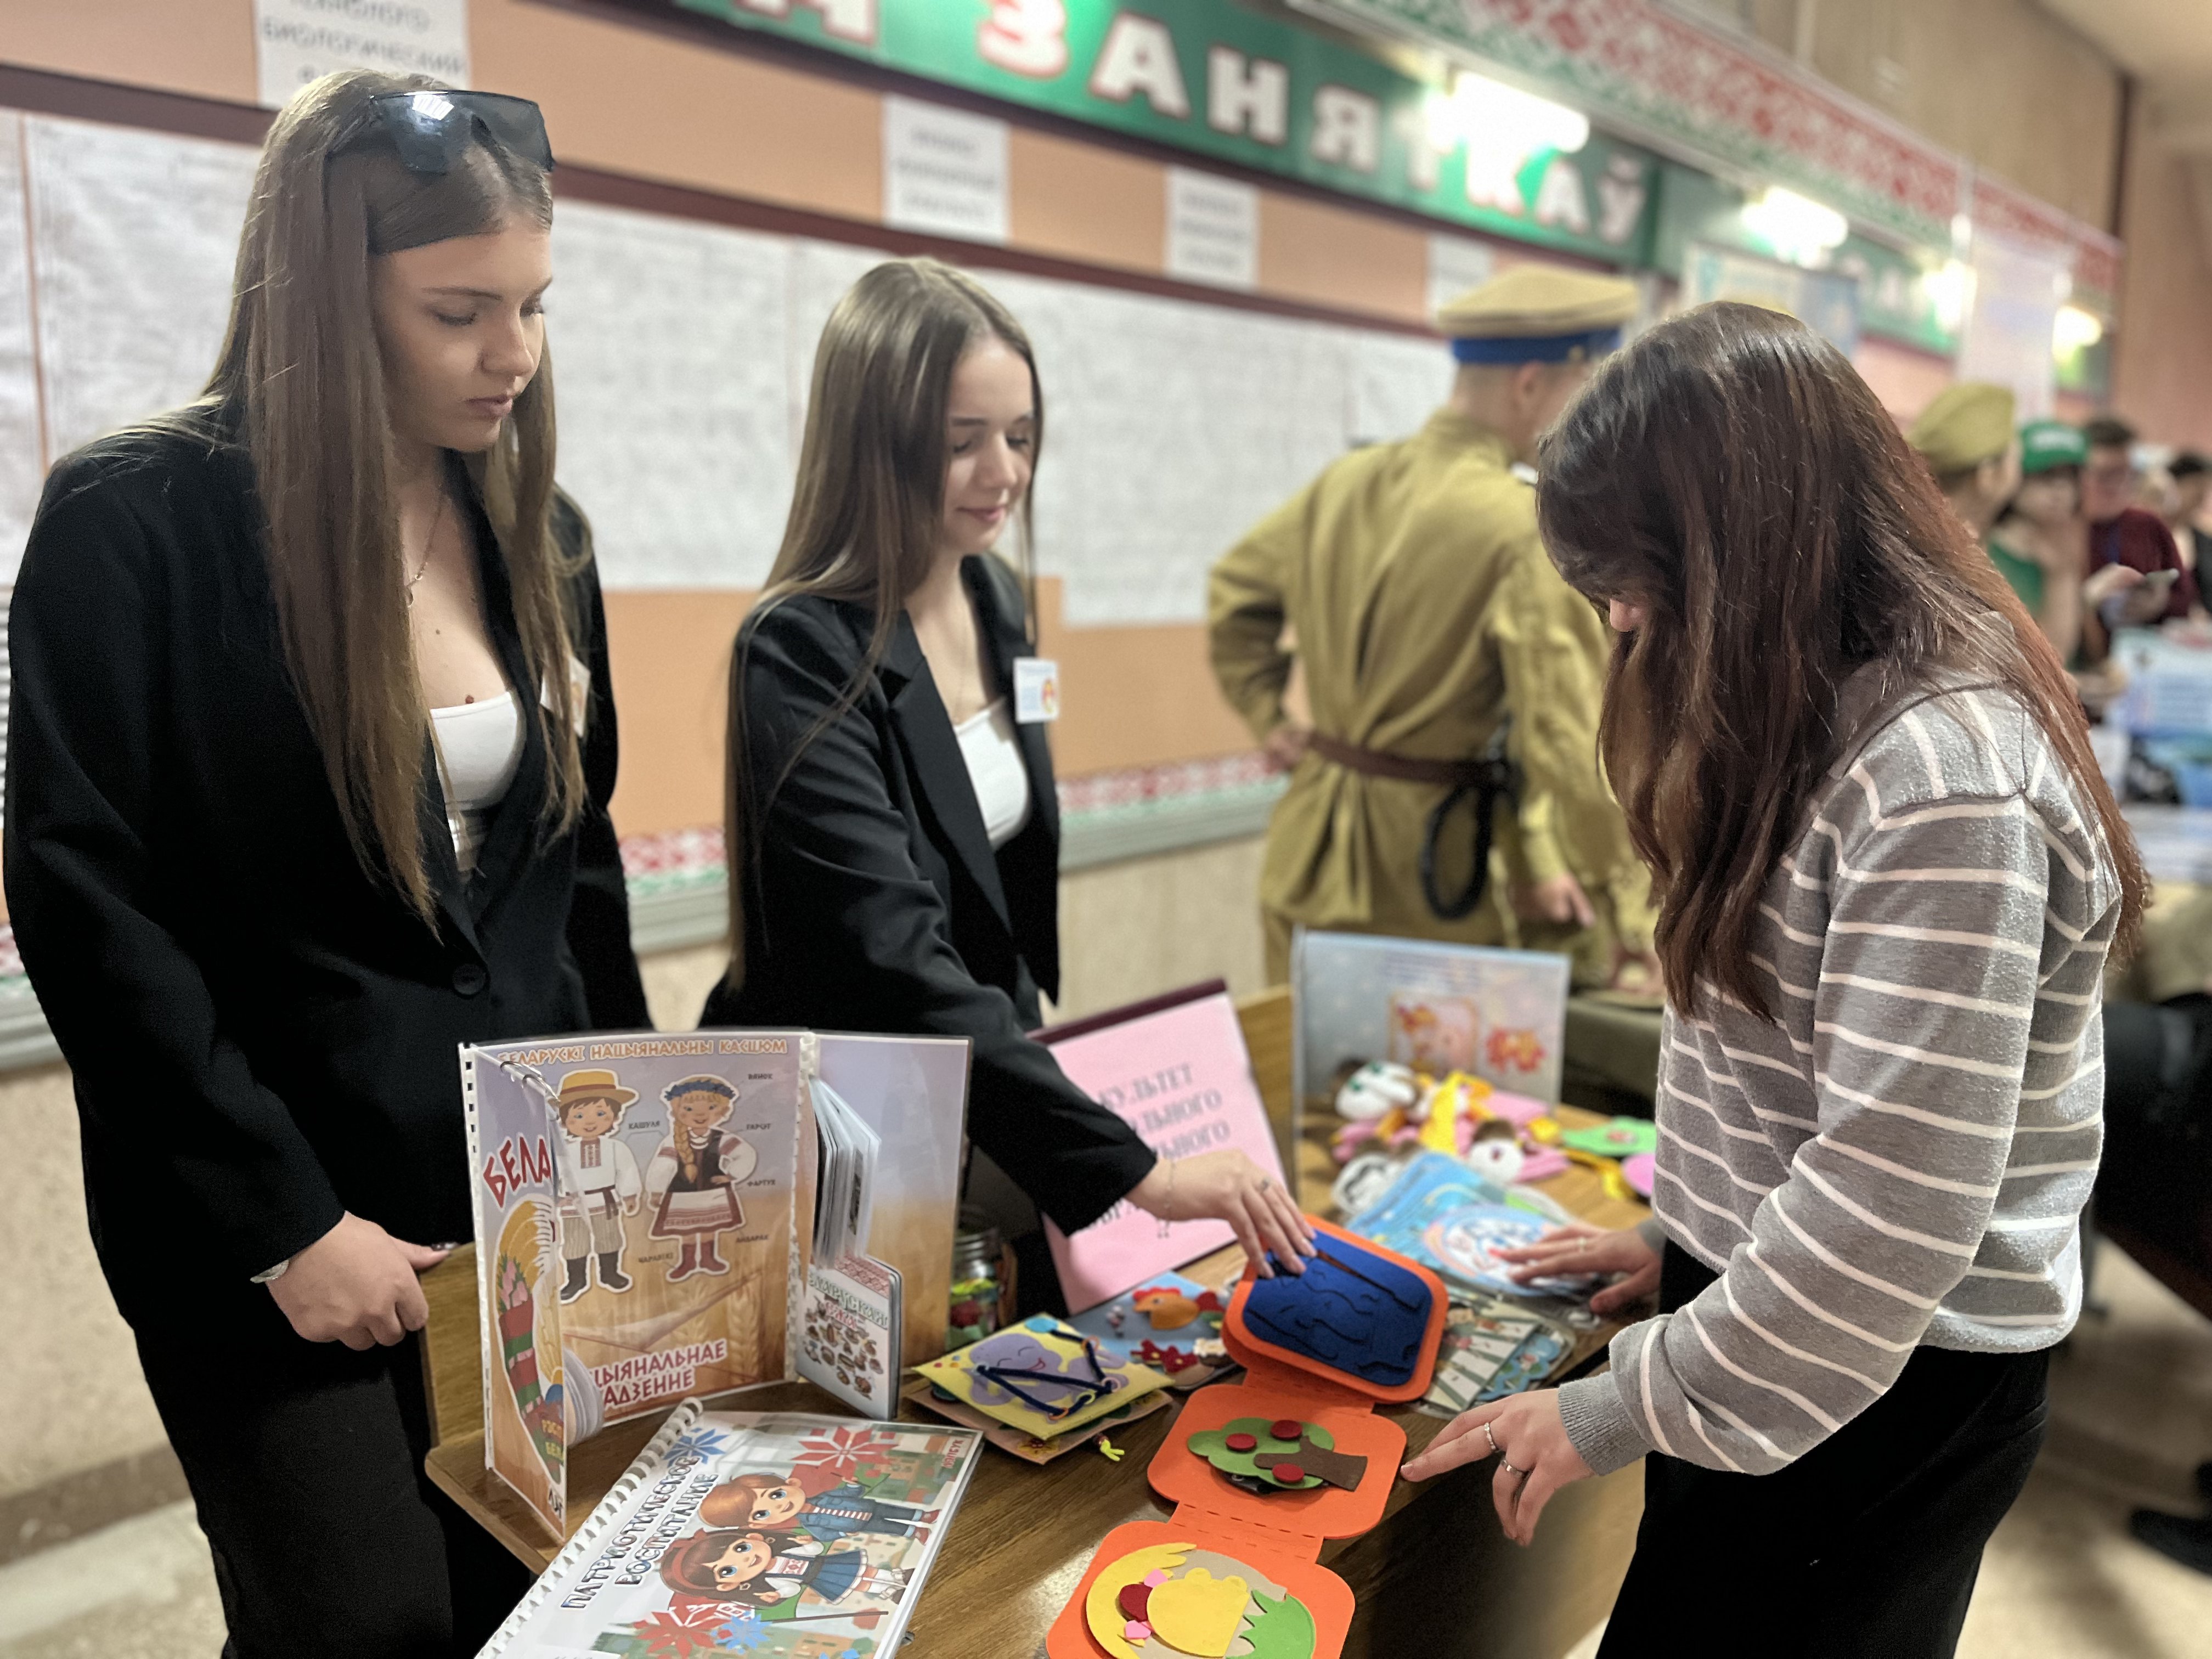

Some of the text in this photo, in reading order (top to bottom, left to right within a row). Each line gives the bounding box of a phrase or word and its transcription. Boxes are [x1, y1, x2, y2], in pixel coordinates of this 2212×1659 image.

[590, 1040, 714, 1059] НАЦЫЯНАЛЬНЫ
[628, 1120, 660, 1130] КАШУЛЯ
[603, 1369, 693, 1406] АДЗЕННЕ
[560, 1456, 701, 1609] ПАТРИОТИЧЕСКОЕ
[614, 1474, 719, 1585] ВОСПИТАНИЕ
